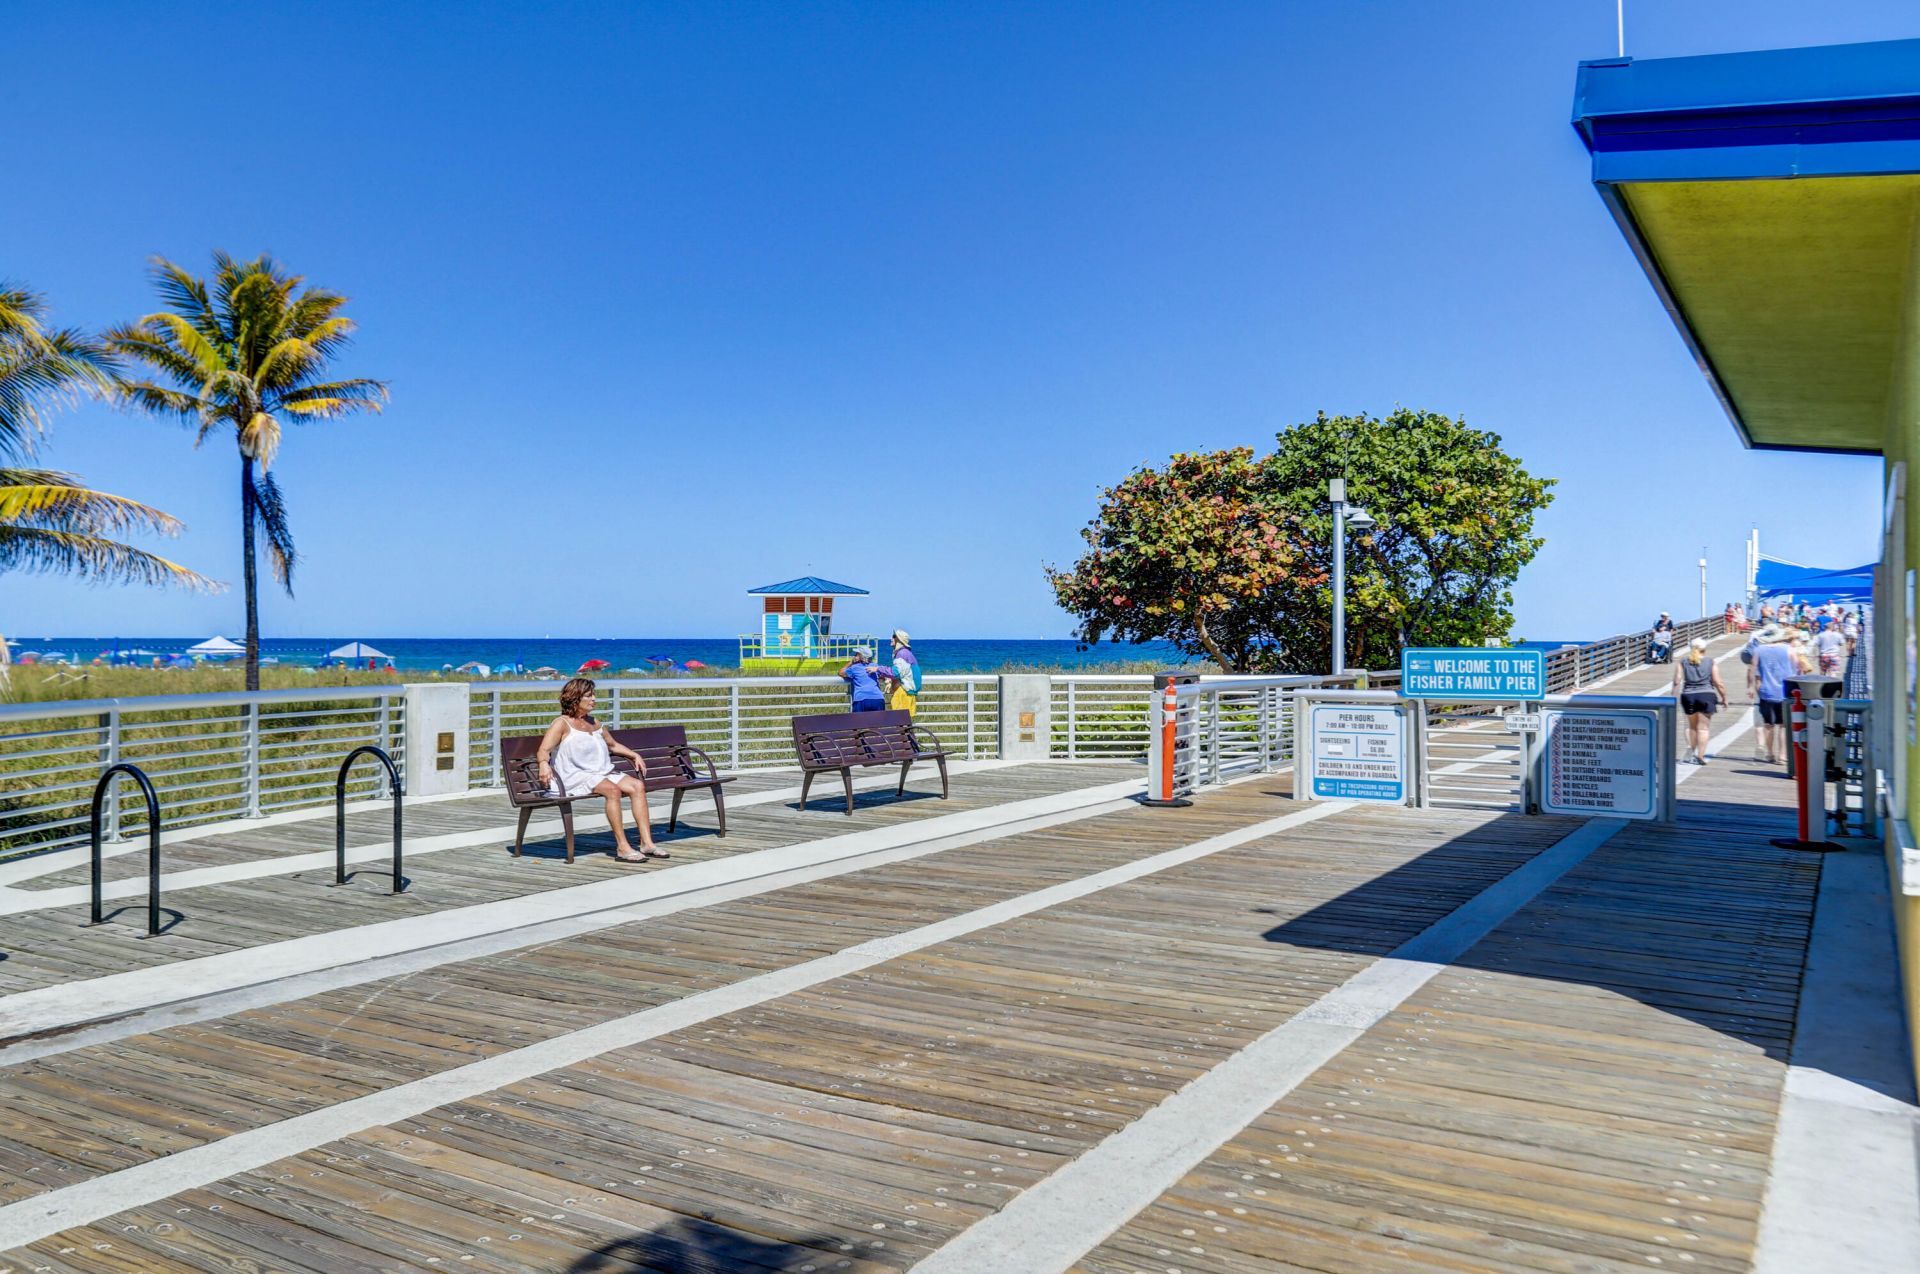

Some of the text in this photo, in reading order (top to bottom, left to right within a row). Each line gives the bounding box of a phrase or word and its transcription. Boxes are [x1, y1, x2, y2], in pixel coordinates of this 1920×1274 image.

[1434, 660, 1491, 673] WELCOME
[1494, 660, 1509, 673] TO
[1512, 660, 1535, 674] THE
[1410, 676, 1535, 690] FISHER FAMILY PIER
[1354, 714, 1375, 722] HOURS
[1572, 791, 1614, 799] ROLLERBLADES
